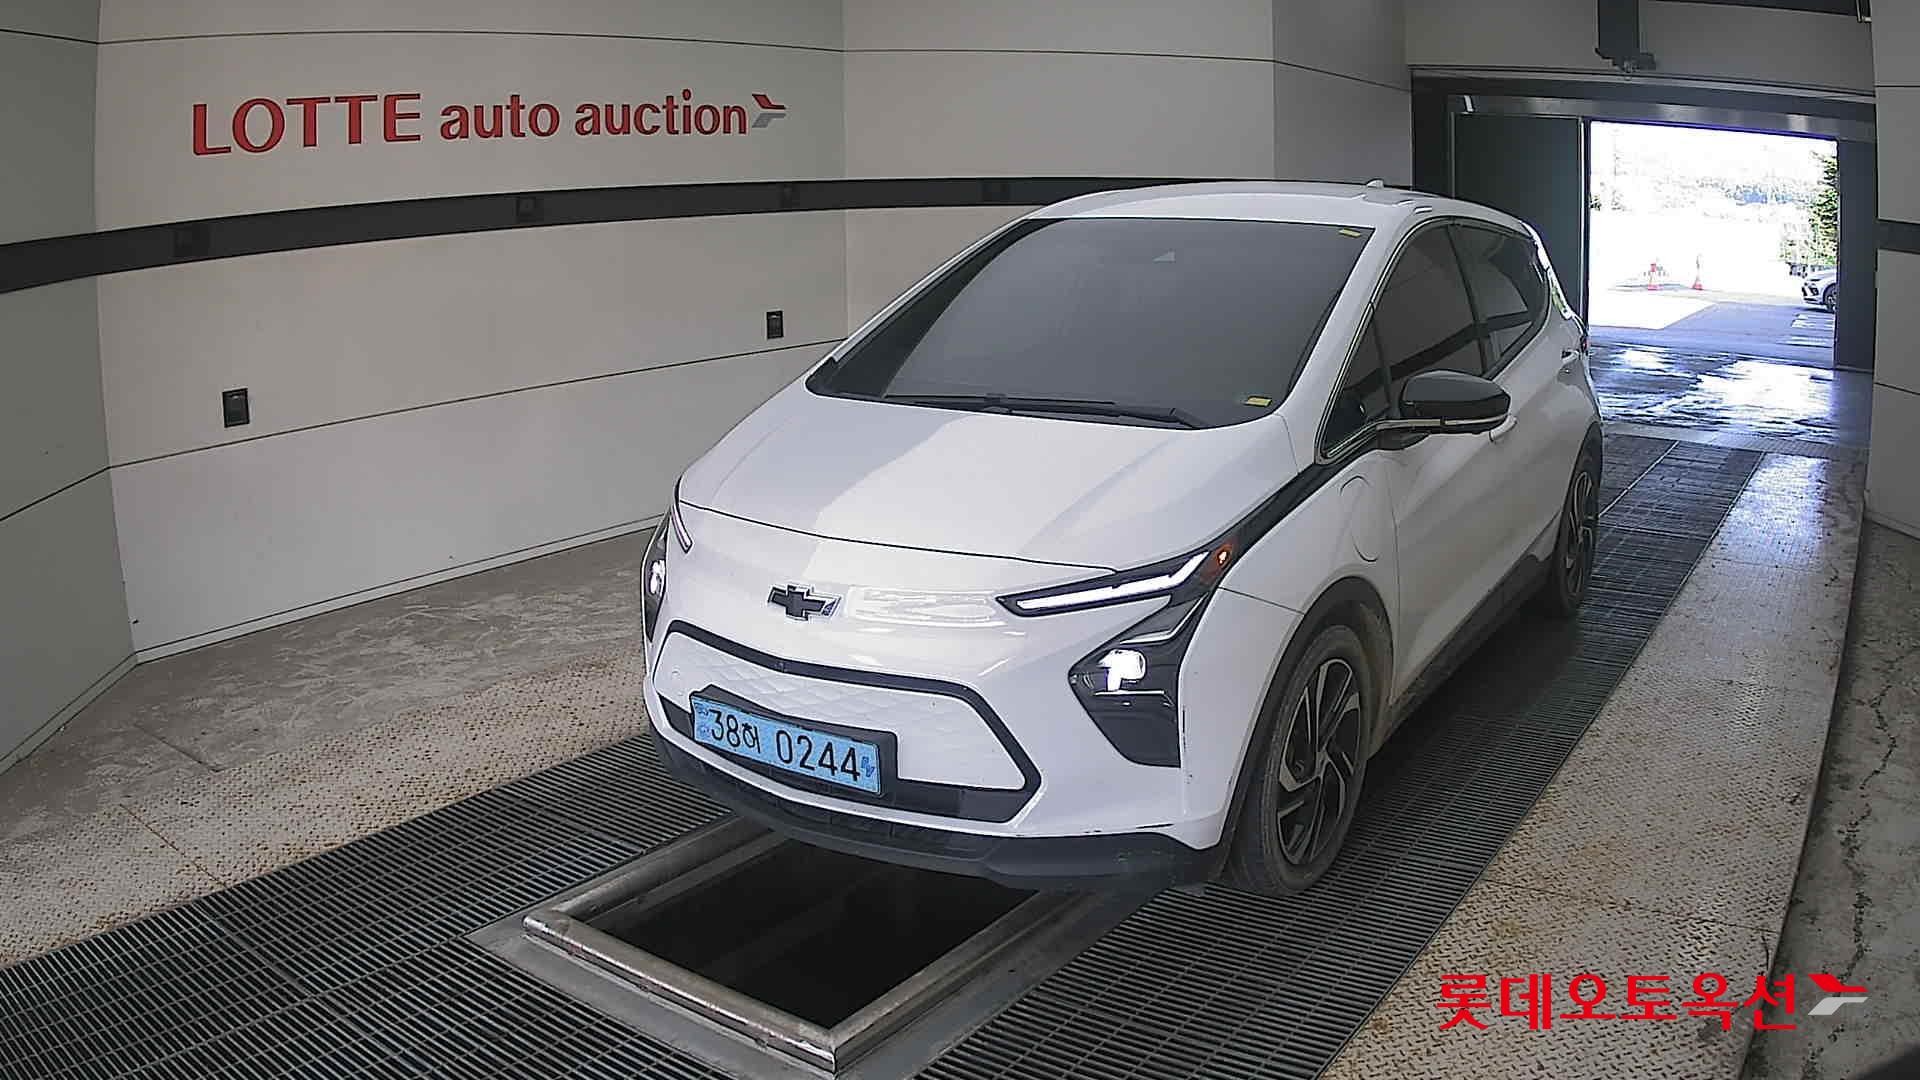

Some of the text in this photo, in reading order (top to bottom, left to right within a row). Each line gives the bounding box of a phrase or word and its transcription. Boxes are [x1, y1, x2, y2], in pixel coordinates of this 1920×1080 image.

[193, 89, 748, 156] LOTTE auto auction
[709, 709, 761, 754] 38허
[776, 729, 860, 782] 0244
